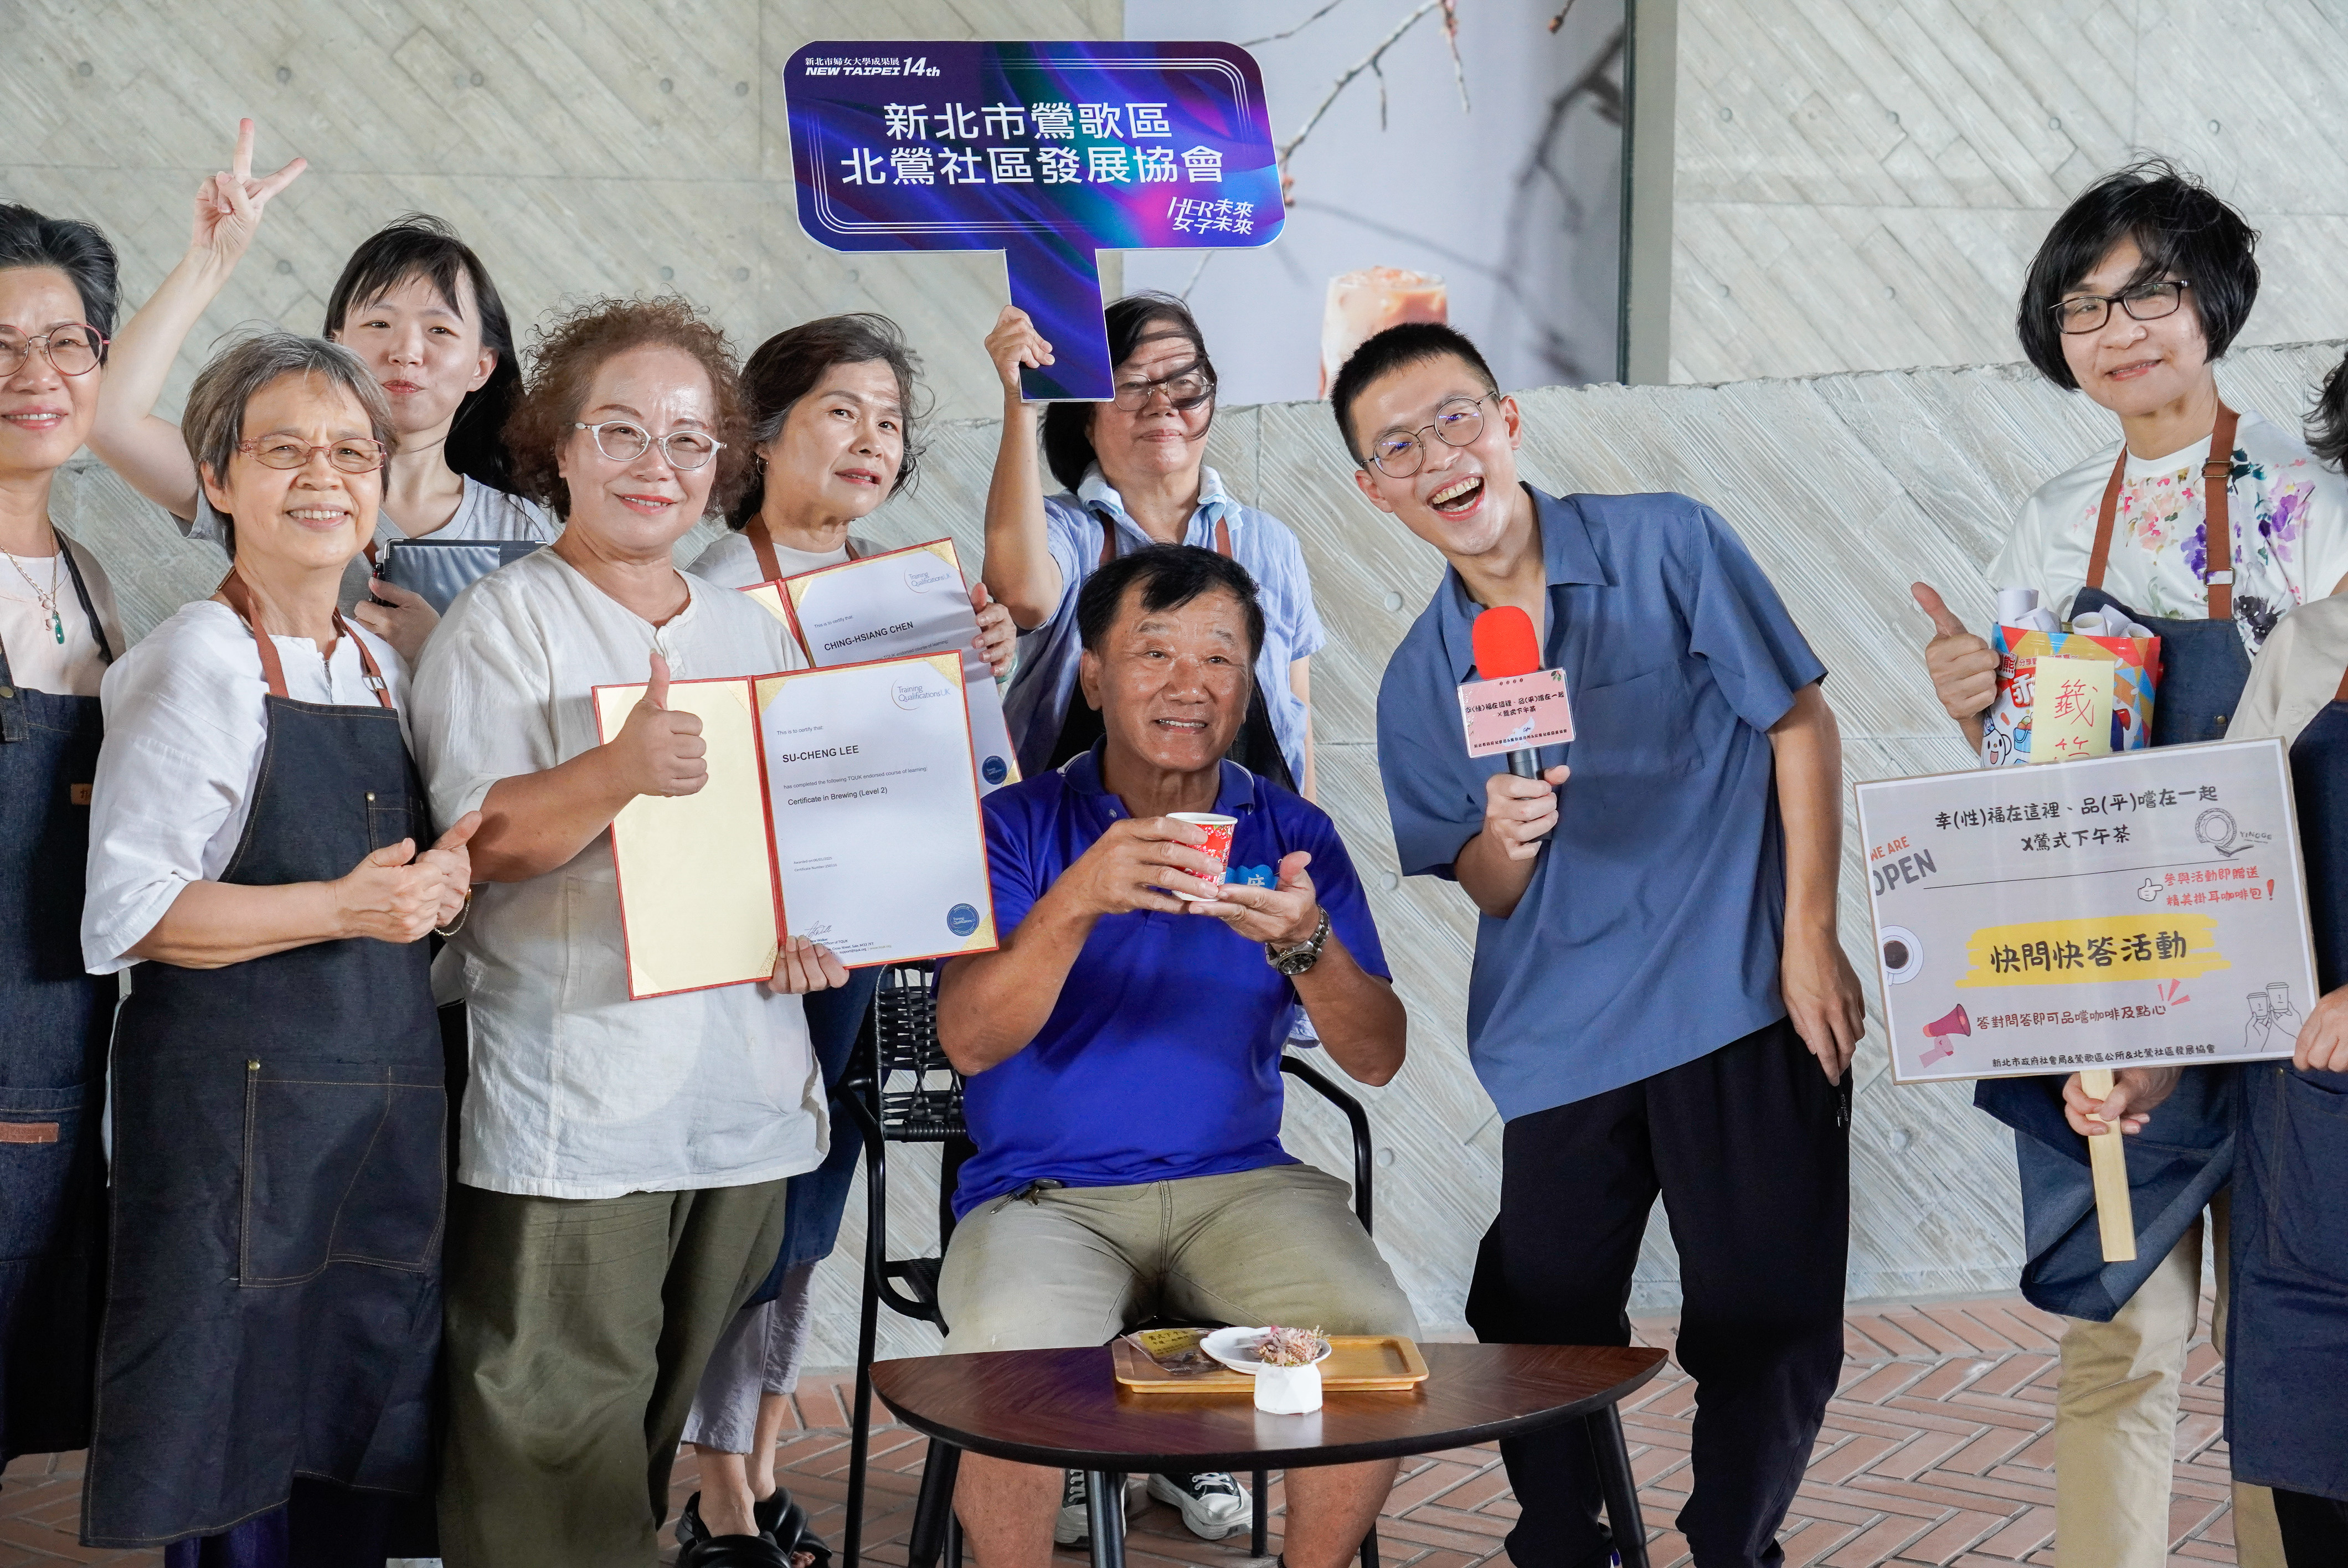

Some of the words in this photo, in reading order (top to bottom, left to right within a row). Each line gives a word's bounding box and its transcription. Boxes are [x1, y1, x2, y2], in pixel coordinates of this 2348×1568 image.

[805, 57, 900, 66] 新北市婦女大學成果展
[805, 66, 841, 76] NEW
[842, 66, 901, 76] TAIPEI
[903, 56, 941, 77] 14th
[883, 102, 1173, 141] 新北市鶯歌區
[841, 145, 1224, 186] 北鶯社區發展協會
[1172, 215, 1254, 235] 女子未來
[908, 572, 930, 580] Training
[823, 628, 888, 651] CHING-HSIANG
[889, 621, 914, 633] CHEN
[782, 748, 837, 763] SU-CHENG
[840, 745, 859, 756] LEE
[793, 780, 817, 789] completed
[826, 776, 847, 785] following
[788, 795, 822, 806] Certificate
[831, 791, 858, 801] Brewing
[859, 788, 879, 798] (Level
[880, 786, 888, 795] 2)
[1887, 835, 1910, 855] ARE
[2164, 865, 2260, 886] 參與活動即贈送
[1990, 930, 2187, 973] 快問快答活動
[1977, 1005, 2167, 1030] 答對問答即可品嚐咖啡及點心
